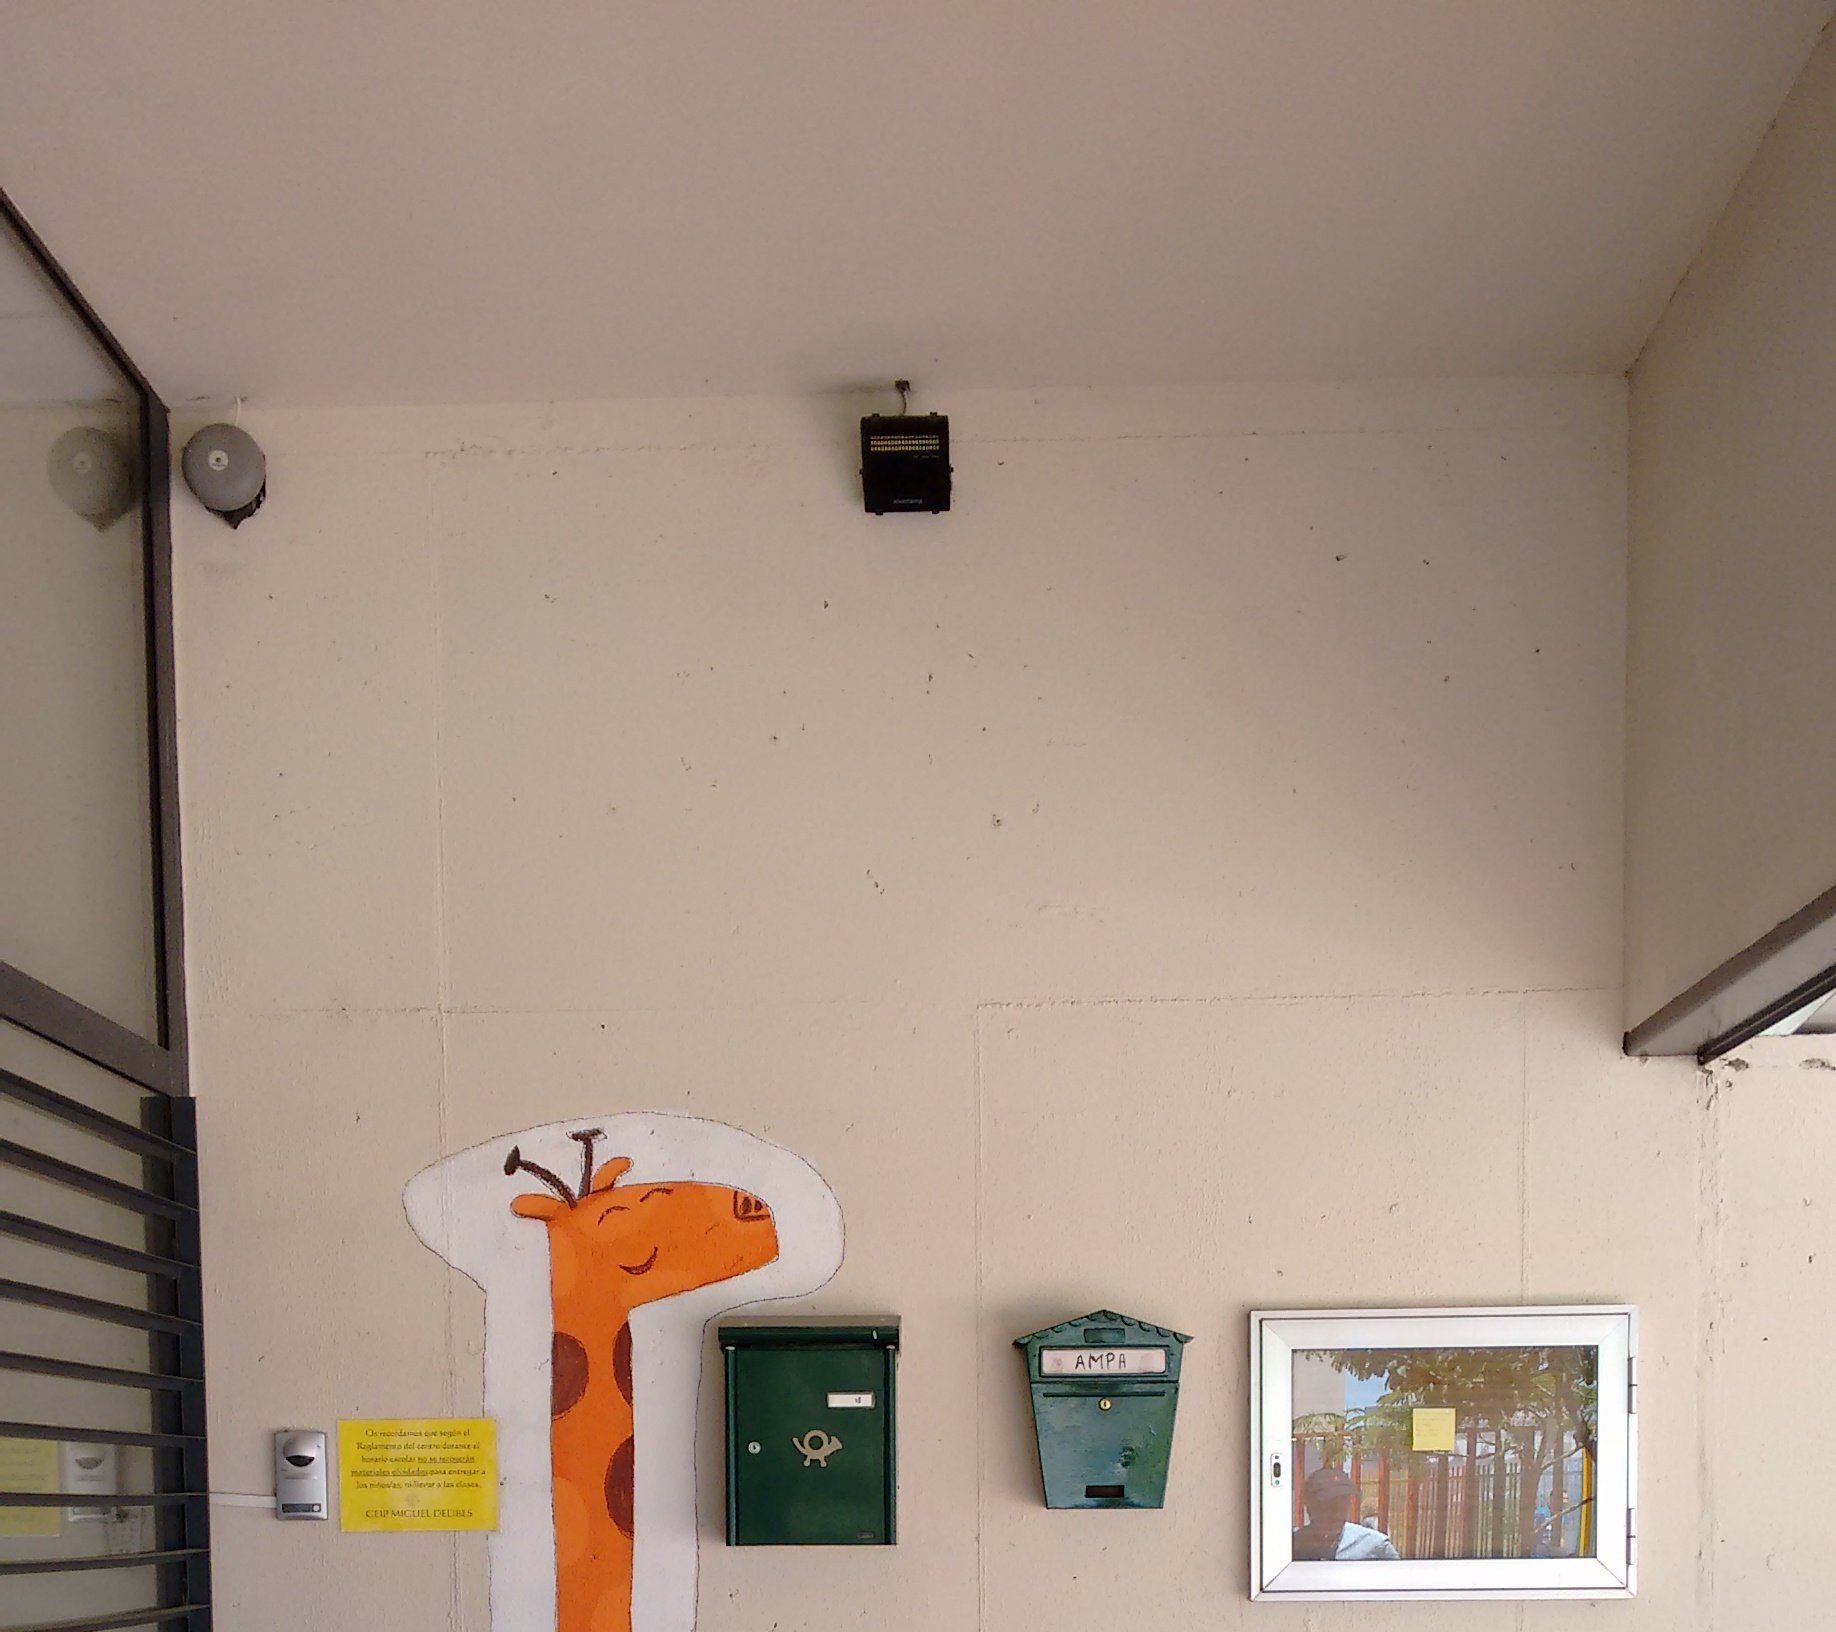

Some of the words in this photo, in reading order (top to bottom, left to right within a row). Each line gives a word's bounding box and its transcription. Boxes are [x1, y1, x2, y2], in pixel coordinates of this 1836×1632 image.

[1075, 1353, 1127, 1370] AMPA
[365, 1510, 389, 1518] CEIP
[391, 1509, 430, 1518] MIGUEL
[433, 1509, 473, 1517] DELIBES
